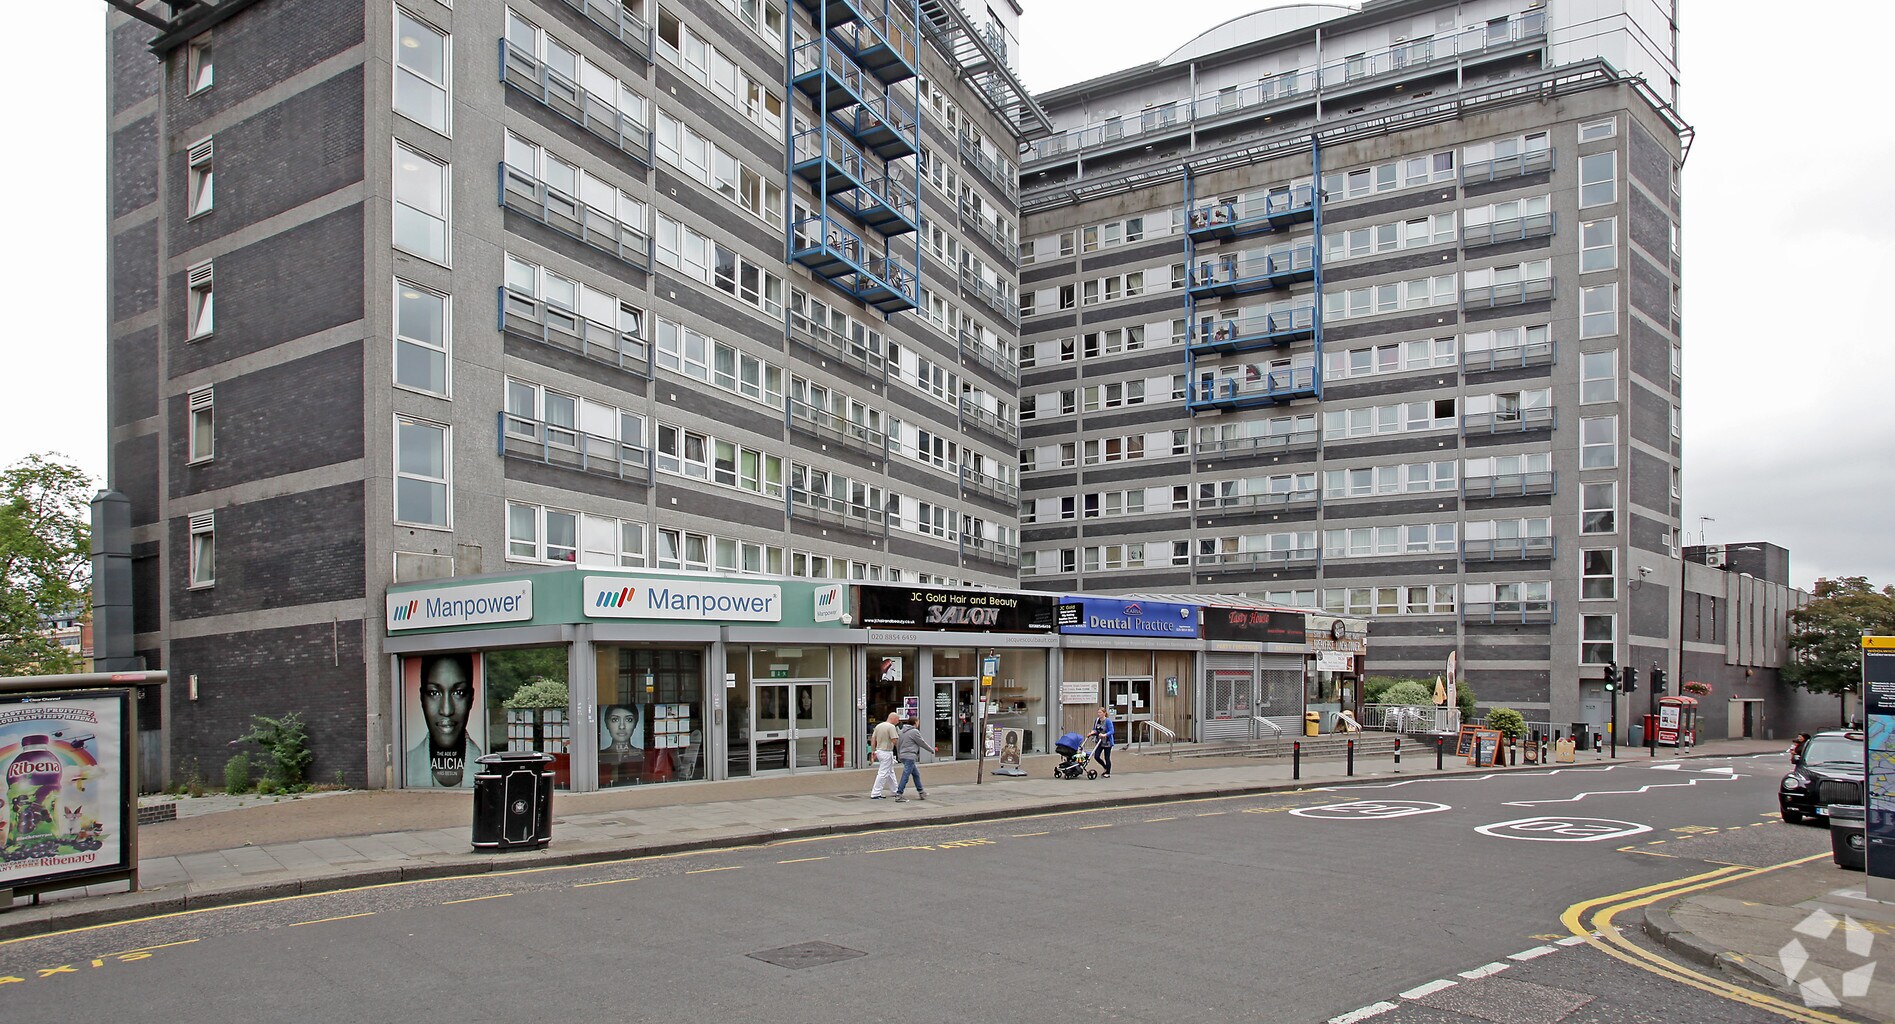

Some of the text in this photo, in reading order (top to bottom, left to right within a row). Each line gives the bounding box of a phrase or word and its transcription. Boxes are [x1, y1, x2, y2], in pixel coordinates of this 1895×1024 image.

[425, 594, 522, 621] Manpower
[647, 587, 774, 616] Manpower
[911, 593, 1018, 608] JC Gold Hair and Beauty
[816, 609, 838, 618] Manpower
[926, 605, 1000, 626] SALON
[1228, 611, 1270, 628] Tasty House
[1090, 615, 1132, 631] Dental
[1135, 617, 1174, 632] Practice
[0, 714, 64, 725] CURRANTIEST
[46, 707, 95, 717] FRUITIEST,
[9, 761, 60, 777] Ribena
[431, 757, 464, 770] ALICIA
[1320, 803, 1421, 815] 20
[40, 852, 96, 867] Ribenary
[0, 951, 153, 985] AXIS
